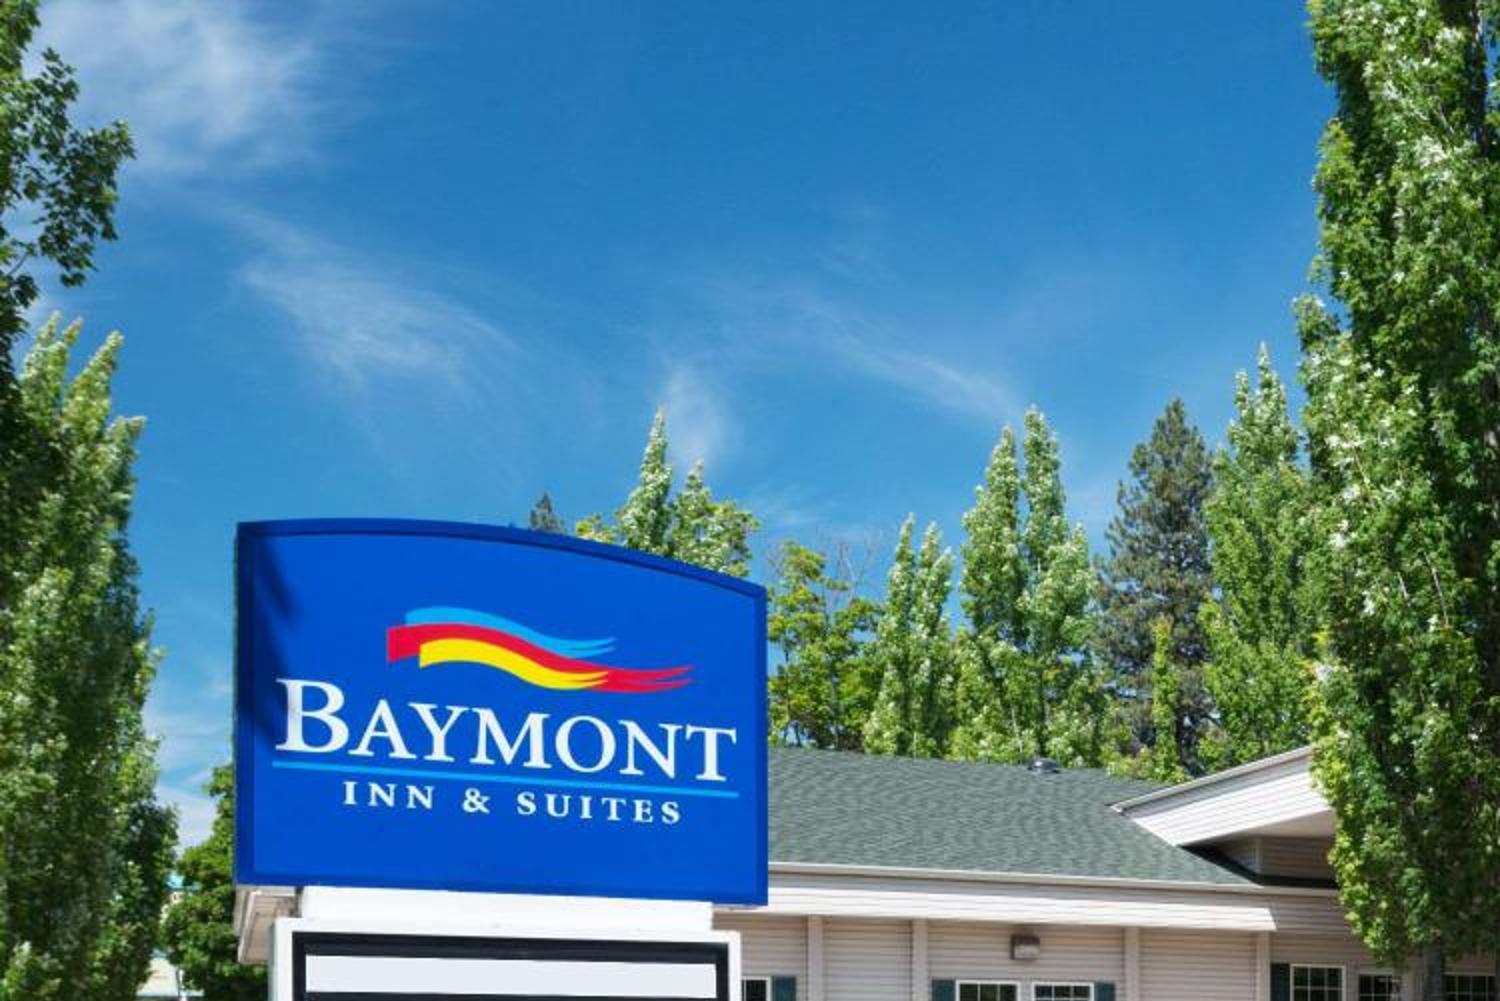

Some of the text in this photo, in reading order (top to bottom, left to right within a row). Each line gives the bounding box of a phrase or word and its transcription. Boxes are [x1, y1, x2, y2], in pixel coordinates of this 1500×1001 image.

[275, 678, 737, 782] BAYMONT
[343, 781, 682, 824] INN & SUITES
